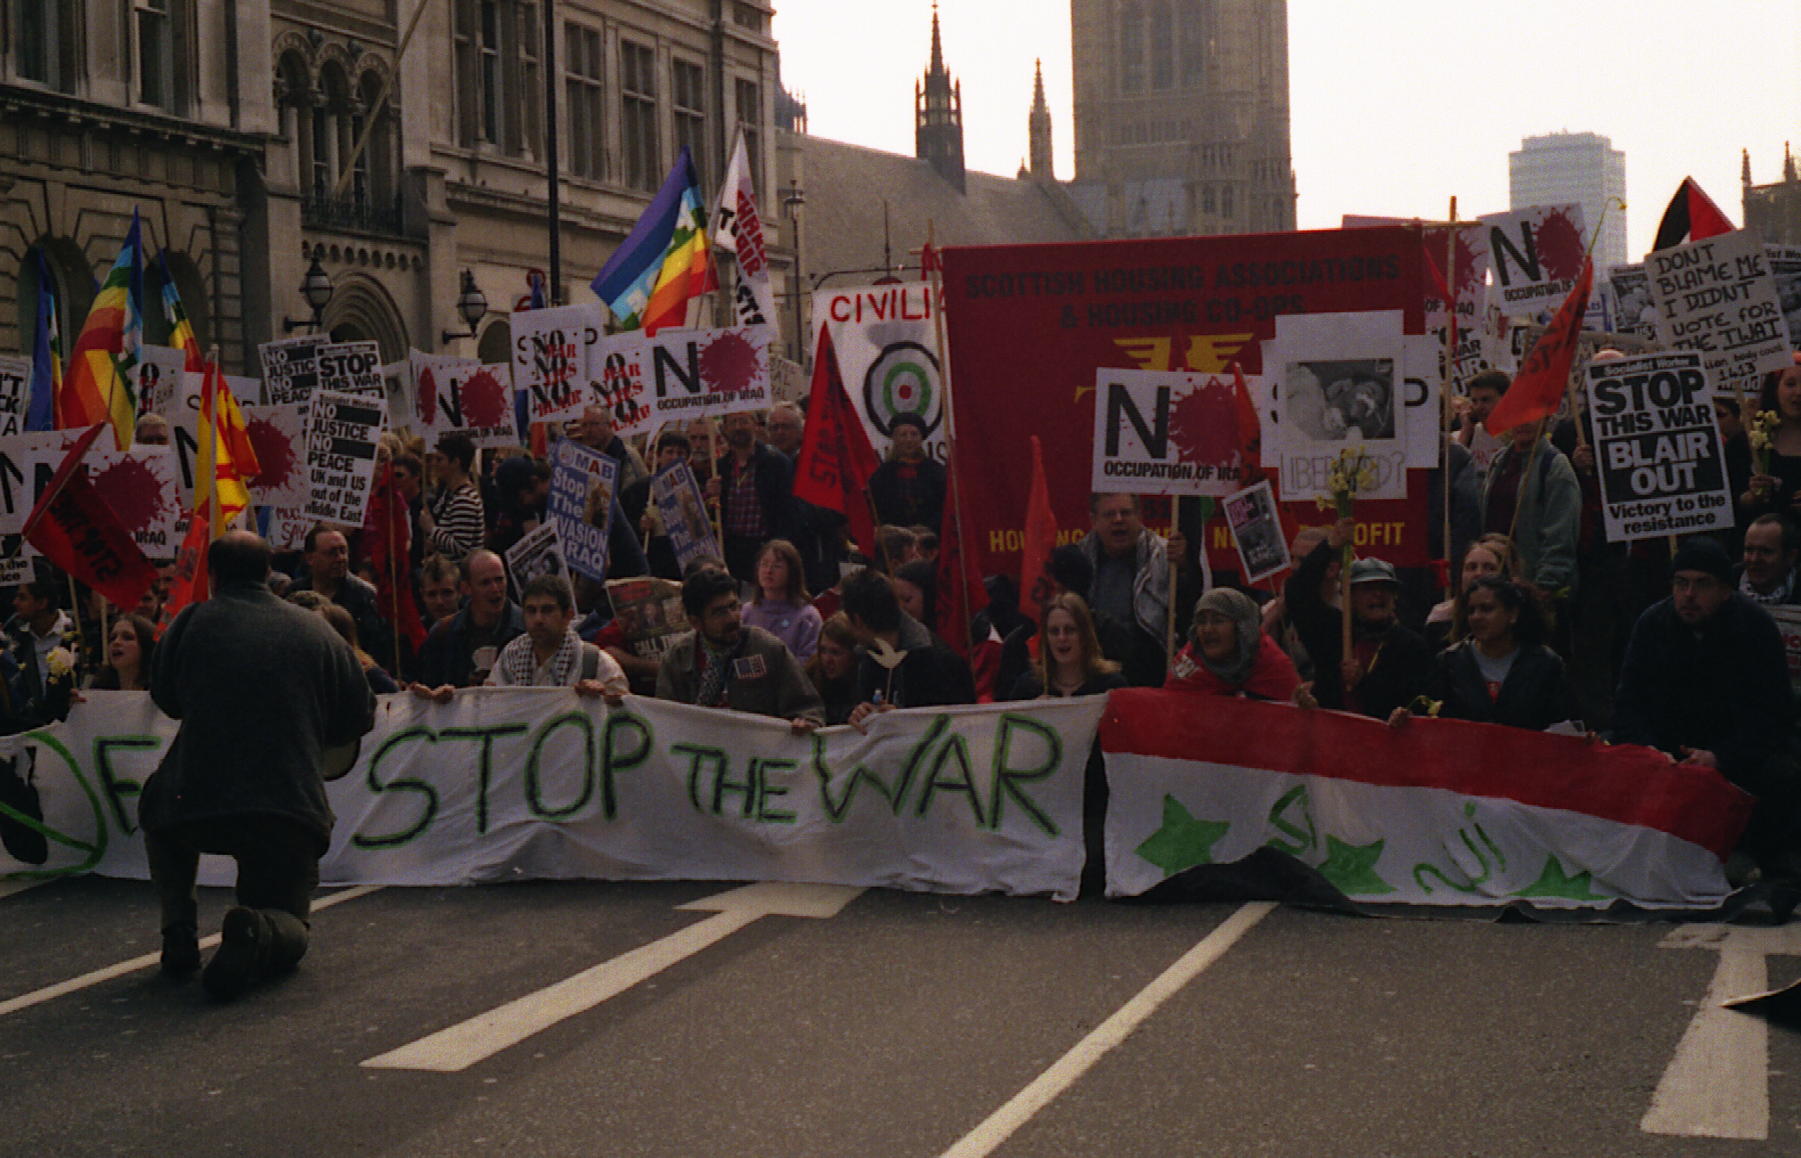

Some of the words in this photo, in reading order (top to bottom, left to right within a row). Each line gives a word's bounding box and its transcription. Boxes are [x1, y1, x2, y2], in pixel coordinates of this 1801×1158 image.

[1655, 244, 1714, 275] DONT
[966, 270, 1084, 299] SCOTTISH
[1094, 264, 1204, 294] HOUSING
[1215, 253, 1400, 288] ASSOCIATIONS
[1656, 262, 1733, 295] BLAME
[1735, 255, 1765, 279] ME
[1060, 304, 1078, 328] &
[1088, 298, 1198, 328] HOUSING
[1207, 293, 1306, 323] CO-OPS
[1664, 299, 1677, 319] I
[1684, 281, 1755, 311] DIDNT
[263, 350, 289, 366] NO
[269, 360, 316, 378] JUSTIC
[319, 353, 378, 378] STOP
[270, 377, 293, 392] NO
[320, 376, 350, 390] THIS
[353, 373, 381, 387] WAR
[1595, 369, 1705, 415] STOP
[271, 388, 311, 405] PEAC
[657, 394, 720, 410] OCCUPATION
[311, 401, 338, 419] NO
[1596, 412, 1653, 436] THIS
[1658, 405, 1712, 429] WAR
[310, 433, 334, 452] NO
[311, 419, 368, 441] JUSTICE
[308, 451, 354, 472] PEACE
[1607, 432, 1712, 470] BLAIR
[574, 452, 613, 480] MAB
[1104, 460, 1192, 480] OCCUPATION
[1196, 465, 1213, 480] OF
[1630, 461, 1697, 496] OUT
[310, 469, 326, 484] UK
[327, 474, 347, 489] and
[351, 476, 366, 491] US
[553, 466, 586, 502] Stop
[311, 488, 327, 501] out
[329, 489, 341, 503] of
[345, 491, 361, 506] the
[551, 491, 584, 519] The
[1608, 500, 1671, 520] Victory
[1676, 498, 1695, 512] to
[1697, 494, 1726, 508] the
[340, 506, 362, 523] East
[1624, 512, 1716, 534] resistance
[1353, 521, 1406, 547] OFIT
[353, 711, 655, 849] STOP
[671, 740, 799, 823] THE
[813, 712, 1065, 837] WAR
